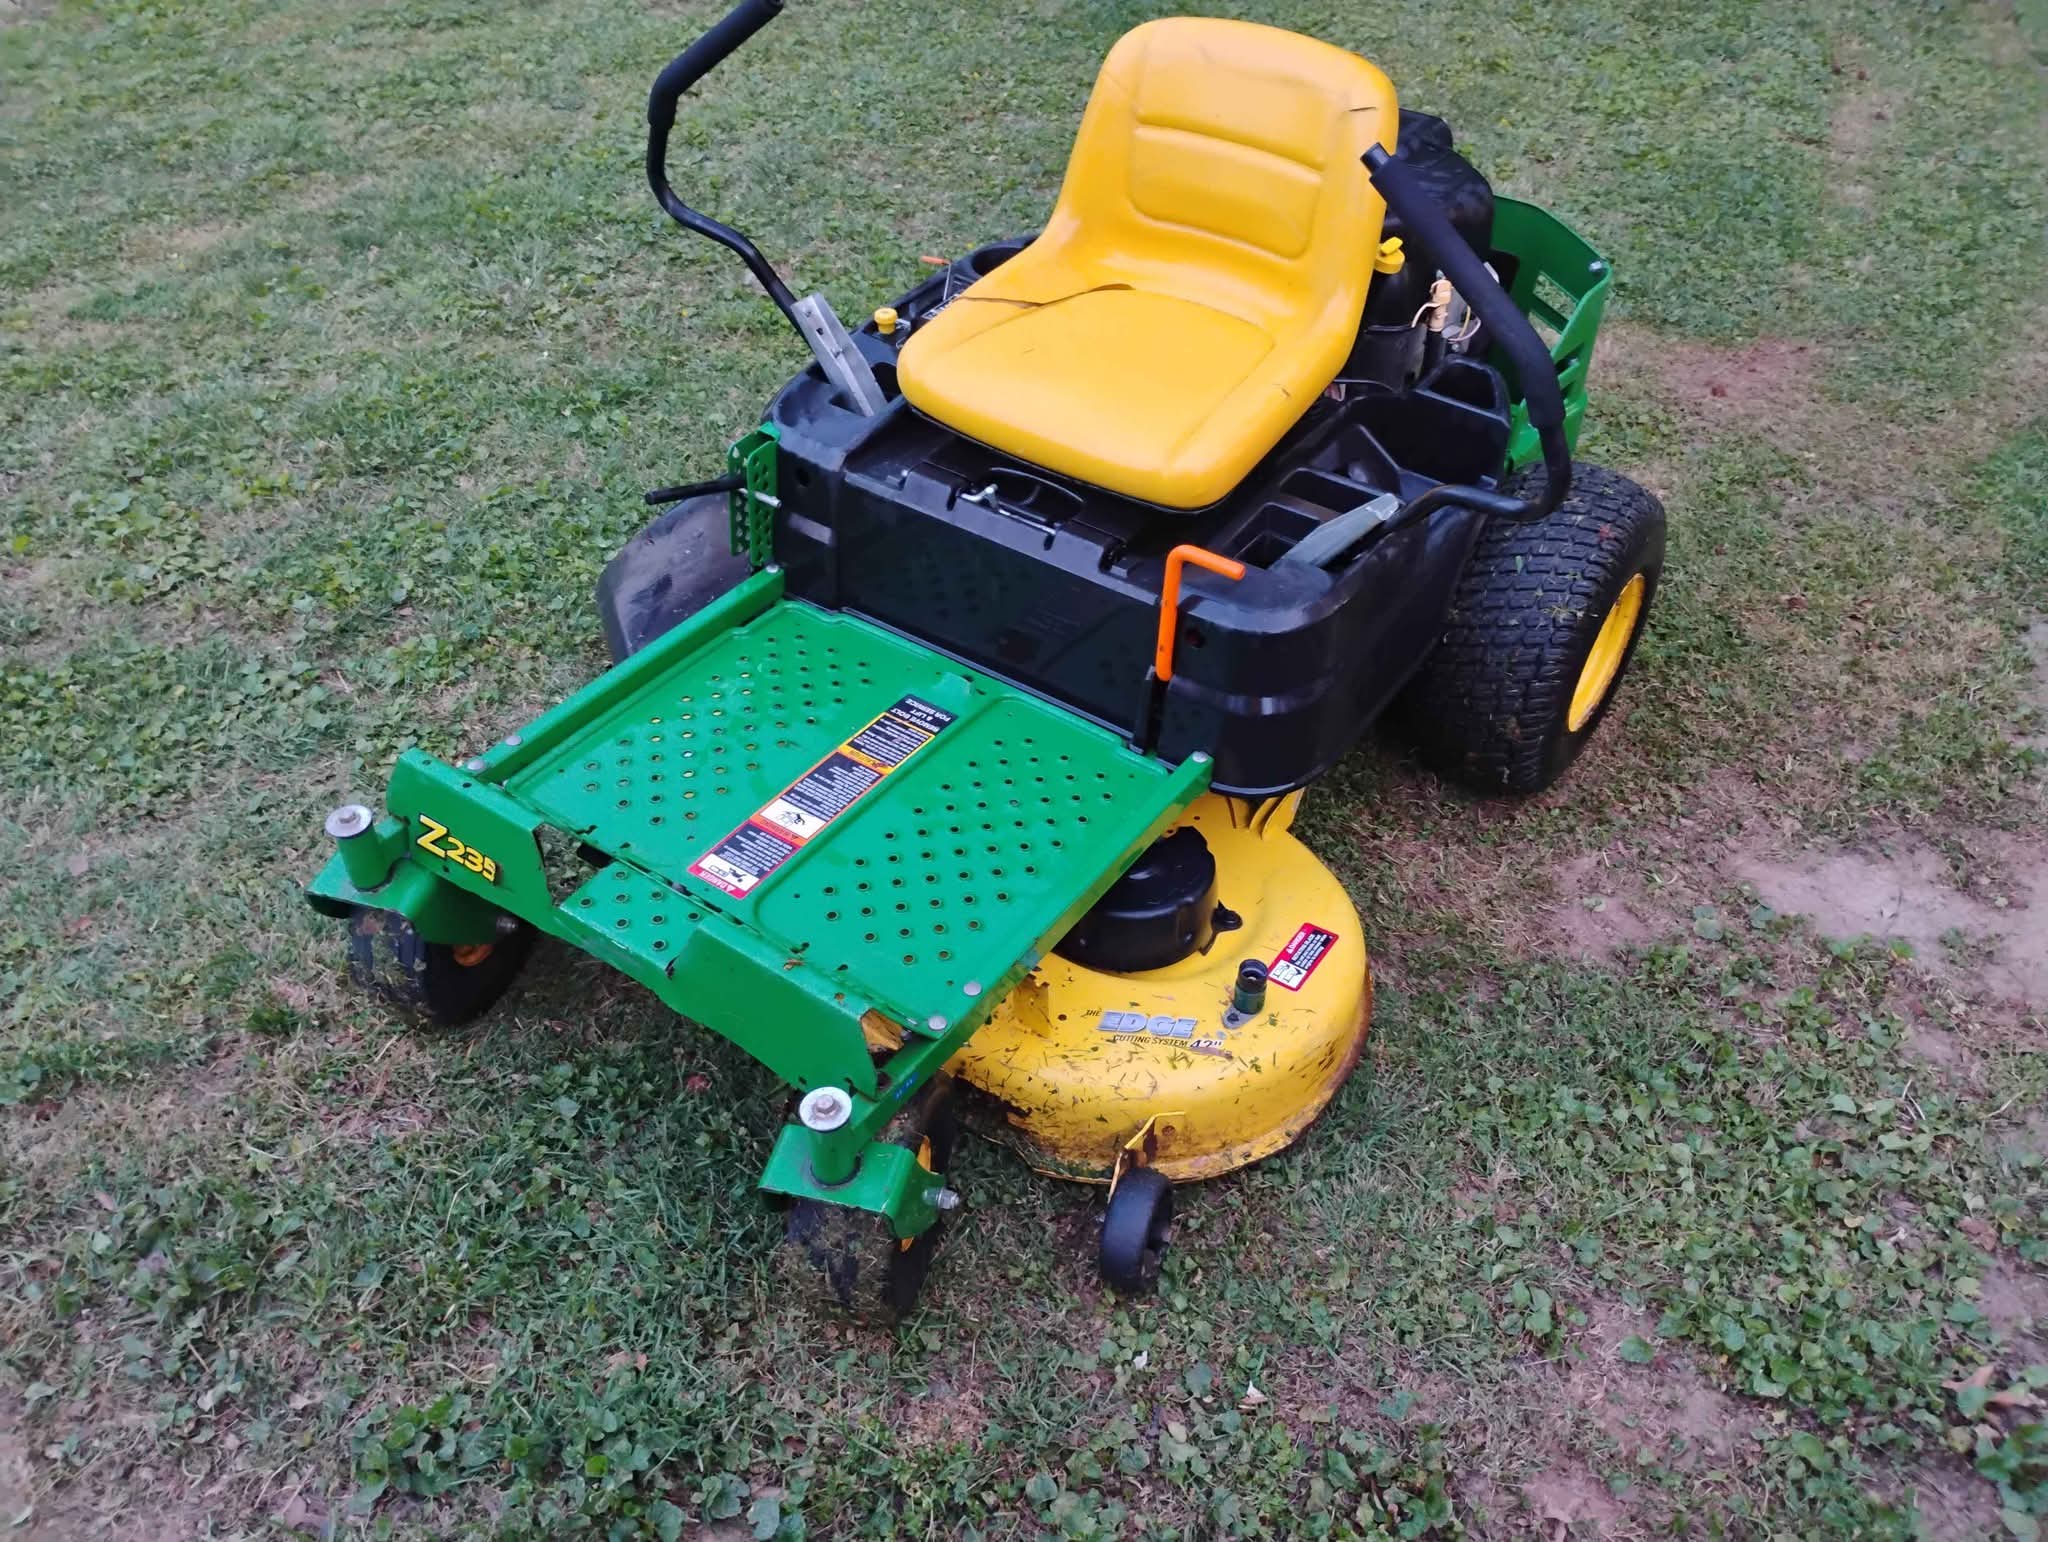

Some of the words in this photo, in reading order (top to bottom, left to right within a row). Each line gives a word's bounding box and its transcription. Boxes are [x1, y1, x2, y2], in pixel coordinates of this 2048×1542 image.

[890, 708, 911, 719] BOLT
[910, 709, 927, 719] LIFT
[934, 711, 952, 722] FOR
[1097, 1011, 1198, 1039] EDGE
[1114, 1034, 1150, 1044] CUTTING
[1151, 1036, 1188, 1048] SYSTEM
